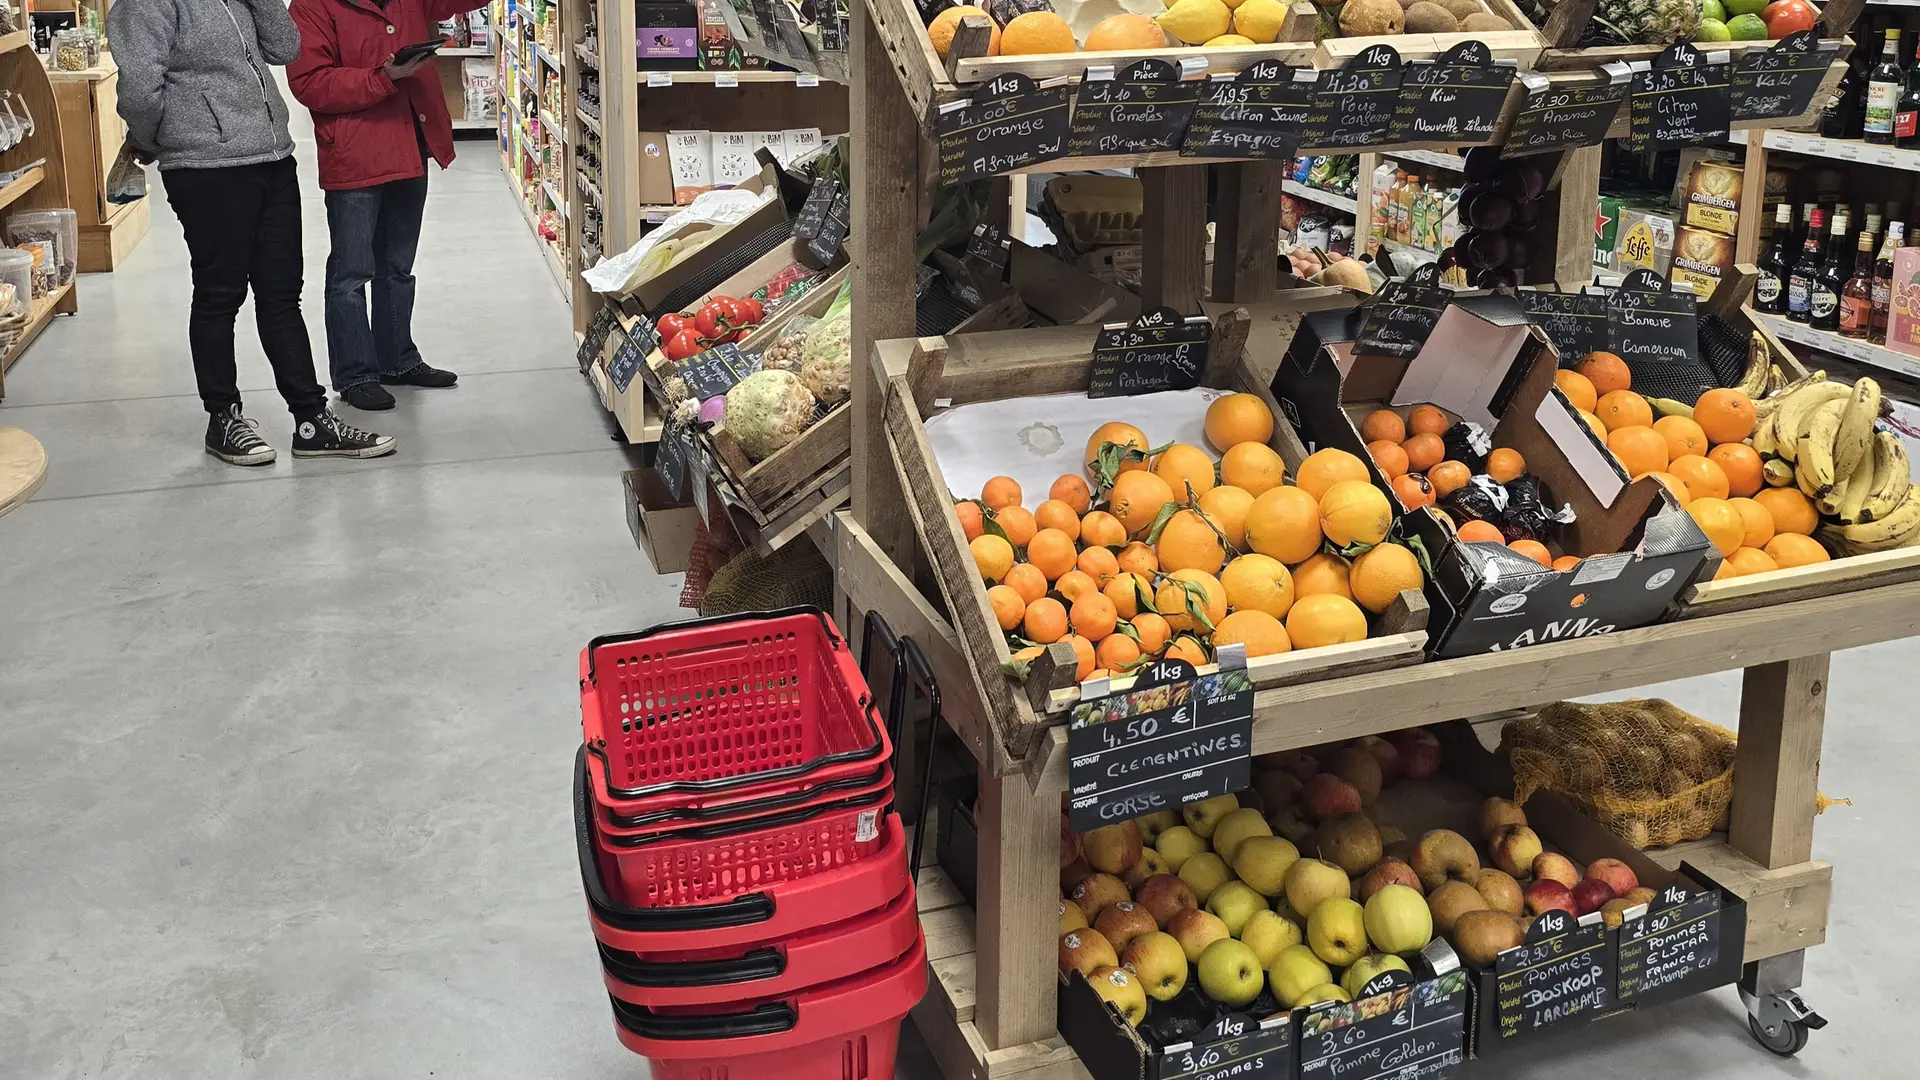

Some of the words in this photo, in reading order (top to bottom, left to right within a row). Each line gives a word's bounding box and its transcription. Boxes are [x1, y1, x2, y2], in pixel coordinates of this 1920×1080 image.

[1367, 47, 1391, 66] 1kg
[1674, 45, 1696, 67] 1kg
[1133, 70, 1160, 80] Pièce
[1251, 62, 1278, 79] 1kg
[1373, 73, 1384, 85] €
[1417, 66, 1453, 90] 0,75
[1461, 69, 1472, 81] €
[1680, 72, 1690, 84] €
[1756, 72, 1798, 87] Kaki
[988, 78, 1019, 95] 1kg
[1144, 87, 1158, 98] €
[1210, 84, 1253, 106] 4,95
[1259, 87, 1272, 99] €
[1430, 88, 1458, 102] Kiwi
[1530, 94, 1569, 109] 2,30
[1657, 96, 1698, 114] Citron
[1110, 104, 1164, 123] Pomelos
[1220, 103, 1264, 122] Citron
[1270, 107, 1308, 123] Jaune
[1543, 110, 1596, 124] Ananas
[976, 118, 1044, 141] Orange
[1414, 116, 1458, 133] Nouvelle
[1209, 129, 1281, 149] Espagne
[973, 152, 1029, 174] Afrique
[1691, 192, 1736, 209] GRIMBERGEN
[1700, 209, 1723, 220] BLONDE
[1415, 266, 1434, 282] 1kg
[1675, 256, 1721, 276] GRIMBERGEN
[1684, 274, 1708, 286] BLONDE
[1647, 296, 1656, 306] €
[1136, 311, 1163, 328] 1kg
[1622, 308, 1671, 328] Banane
[1111, 333, 1144, 348] 2,30
[1623, 339, 1687, 358] Cameroun
[1125, 351, 1172, 365] Orange
[1119, 365, 1171, 388] Portugal
[1151, 663, 1182, 681] 1kg
[1103, 717, 1159, 748] 4,50
[1172, 707, 1191, 724] €
[1073, 755, 1100, 768] PRODUIT
[1100, 794, 1166, 820] CORSE
[1664, 886, 1687, 903] 1kg
[1539, 914, 1564, 933] 1kg
[1647, 920, 1706, 951] POMMES
[1553, 940, 1563, 953] €
[1646, 932, 1709, 964] ELSTAR
[1524, 952, 1592, 985] POMMES
[1646, 951, 1696, 979] FRANCE
[1364, 973, 1394, 996] 1kg
[1522, 965, 1604, 1009] BOSKOOP
[1533, 987, 1606, 1028] LARCHAMP
[1216, 1018, 1244, 1036] 1kg
[1321, 1026, 1366, 1055] 3,60
[1392, 1009, 1409, 1026] €
[1182, 1048, 1220, 1074] 3,60
[1303, 1059, 1327, 1072] PRODUIT
[1330, 1047, 1381, 1077] Pomme
